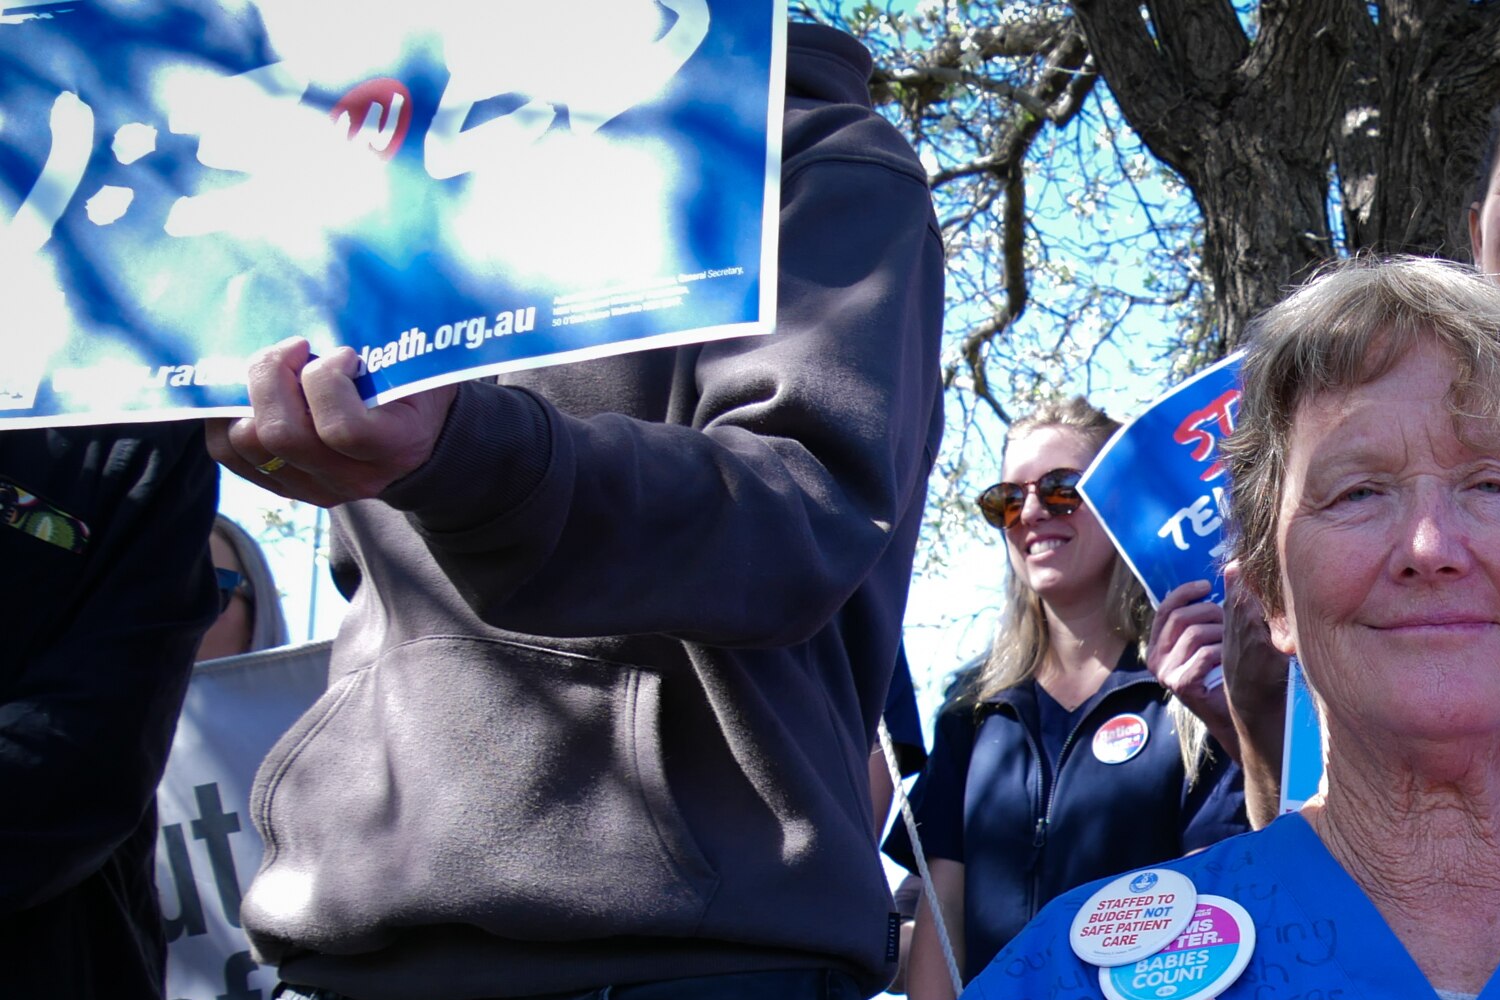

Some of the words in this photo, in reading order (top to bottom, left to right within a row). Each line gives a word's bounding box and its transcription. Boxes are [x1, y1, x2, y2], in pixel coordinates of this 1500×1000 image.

[707, 265, 745, 280] Secretary,
[1097, 896, 1154, 911] STAFFED
[1157, 894, 1175, 905] TO
[1088, 908, 1143, 924] BUDGET
[1143, 906, 1174, 919] NOT
[1080, 923, 1114, 937] SAFE
[1115, 919, 1172, 934] PATIENT
[1102, 934, 1139, 948] CARE
[1134, 950, 1210, 974] BABIES
[1132, 964, 1208, 990] COUNT
